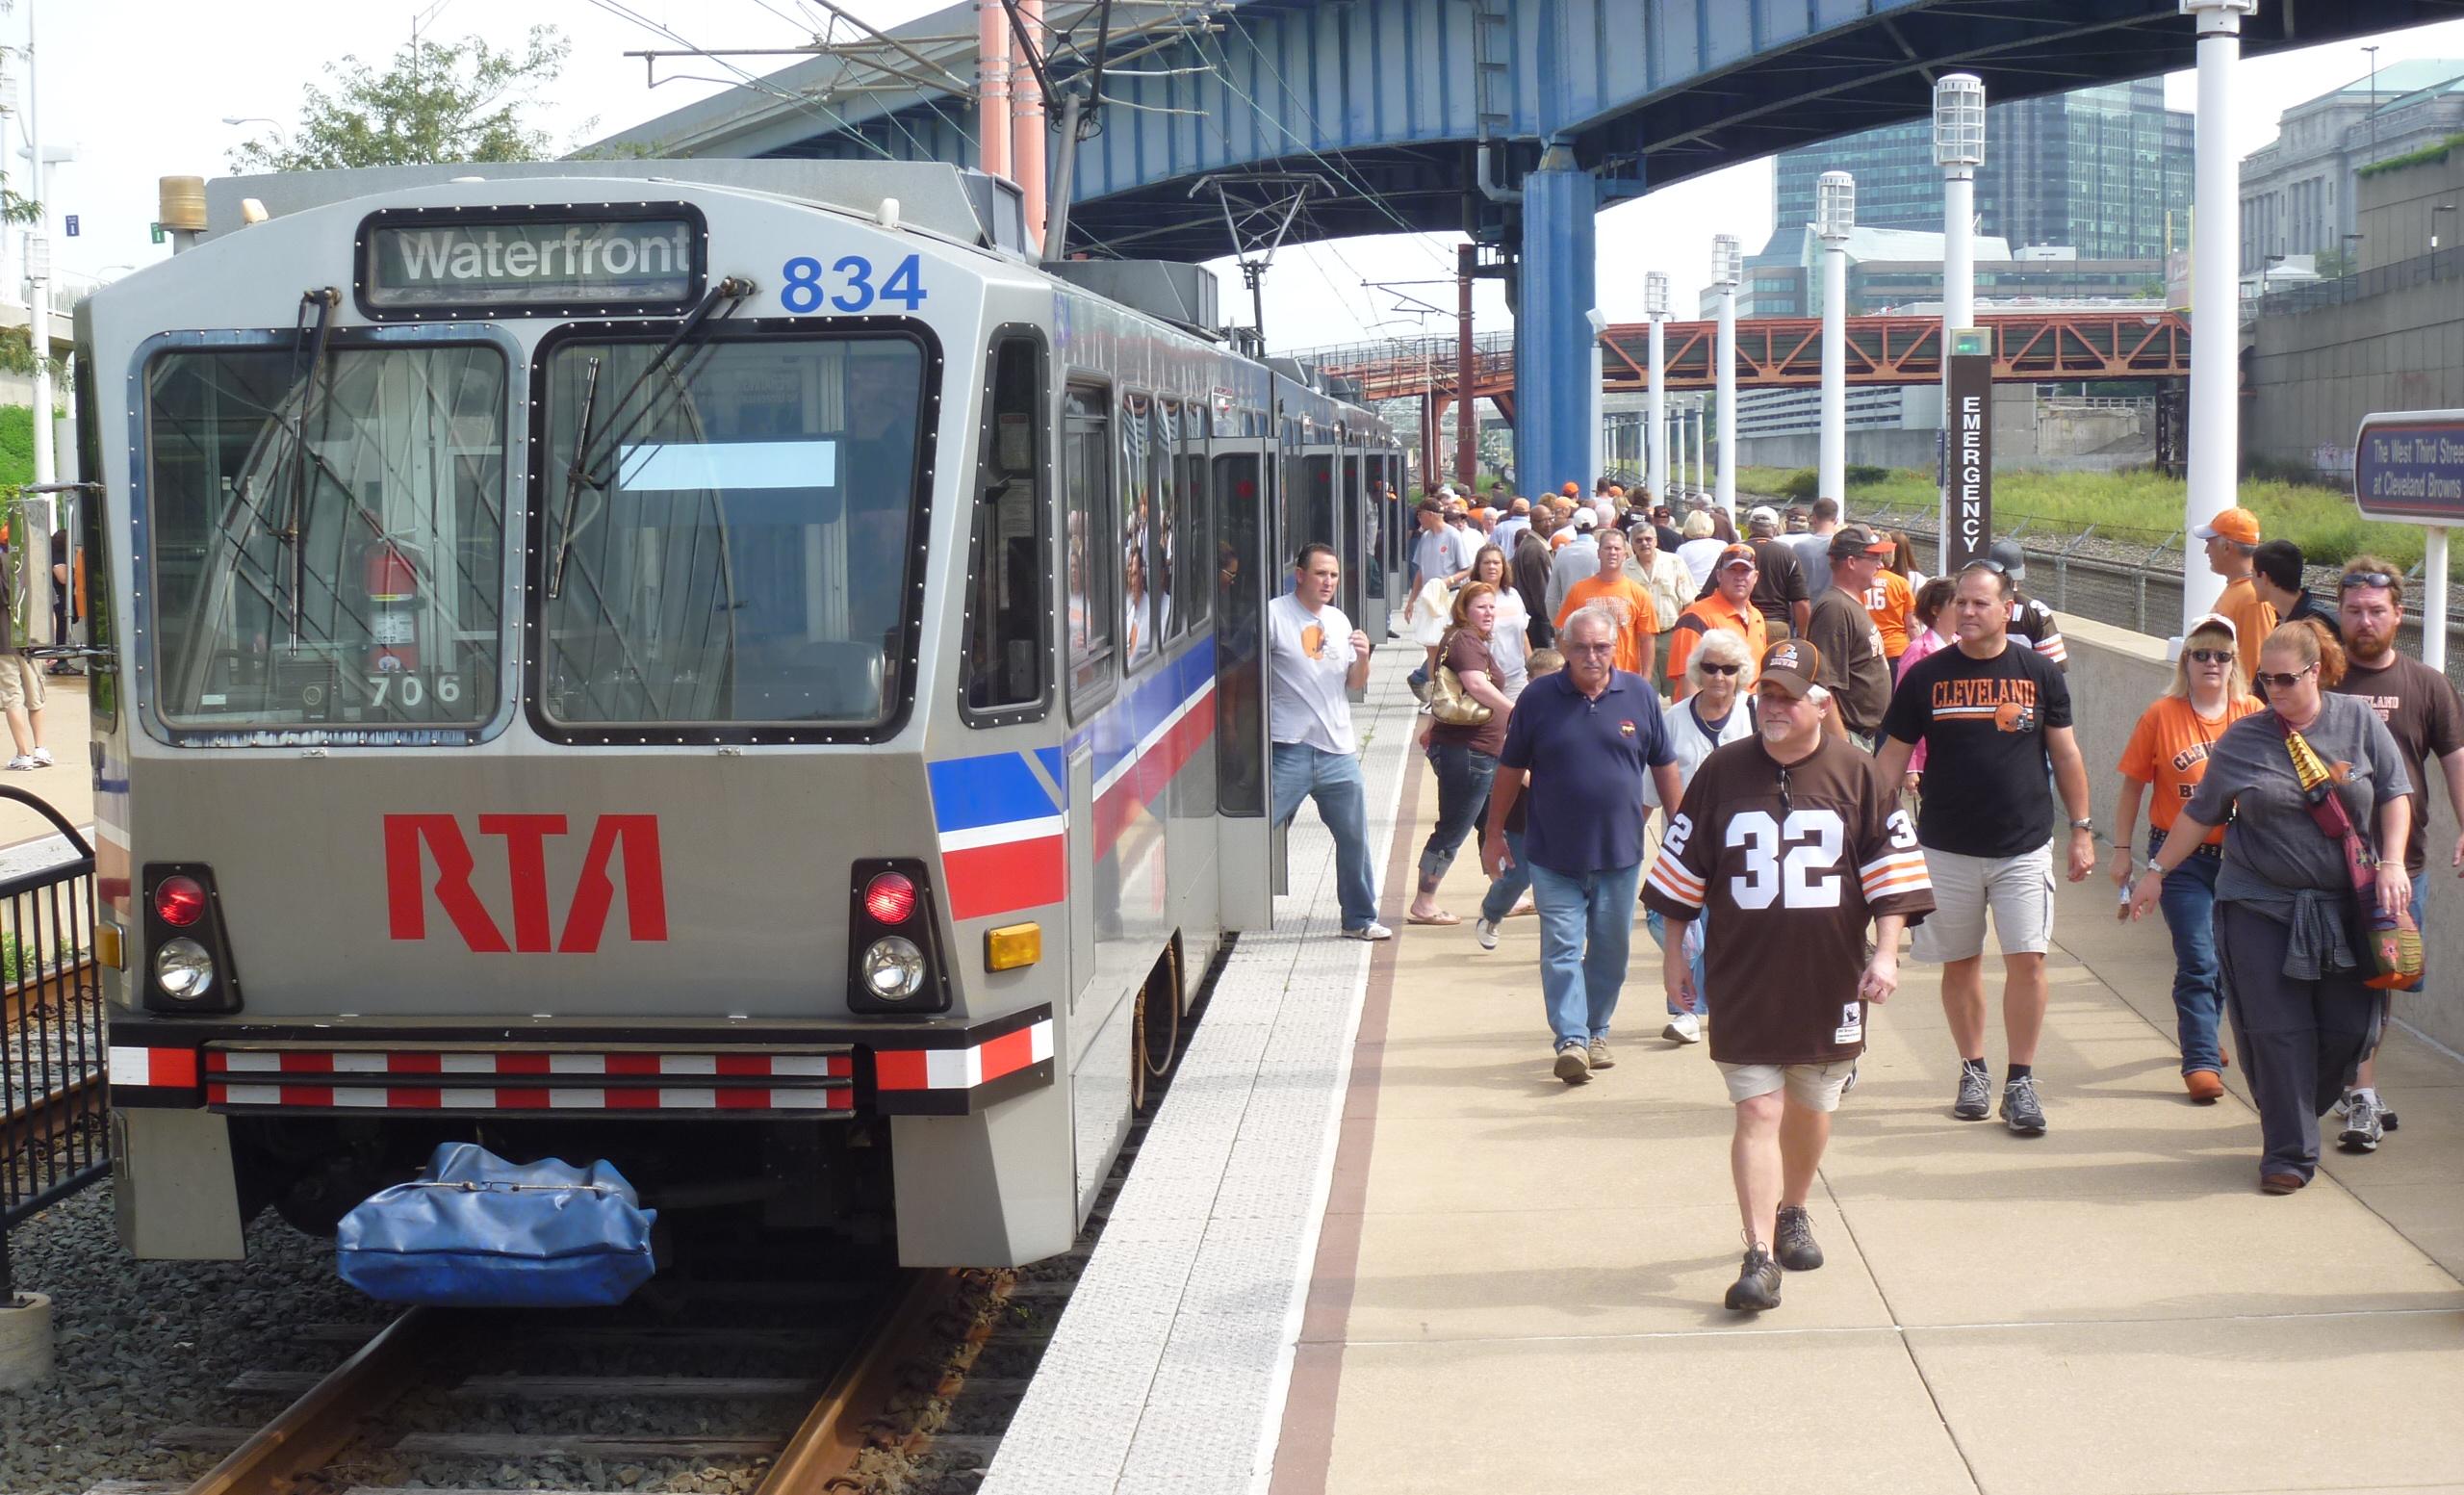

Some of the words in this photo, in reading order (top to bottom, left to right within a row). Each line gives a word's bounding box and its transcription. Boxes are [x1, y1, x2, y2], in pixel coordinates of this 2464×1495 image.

[398, 224, 690, 279] Waterfront
[780, 254, 928, 313] 834
[2373, 439, 2388, 463] The
[2391, 438, 2412, 463] West
[2415, 438, 2437, 464] Third
[1963, 396, 1981, 553] EMERGENCY
[2374, 473, 2381, 495] at
[2383, 471, 2426, 497] Cleveland
[2427, 472, 2461, 499] Browns
[1864, 588, 1886, 609] 16
[369, 675, 460, 707] 706
[1932, 678, 2036, 708] CLEVELAND
[2178, 784, 2197, 800] B
[1662, 812, 1693, 856] 2
[1886, 810, 1917, 848] 3
[1726, 810, 1844, 910] 32
[384, 814, 668, 953] RTA
